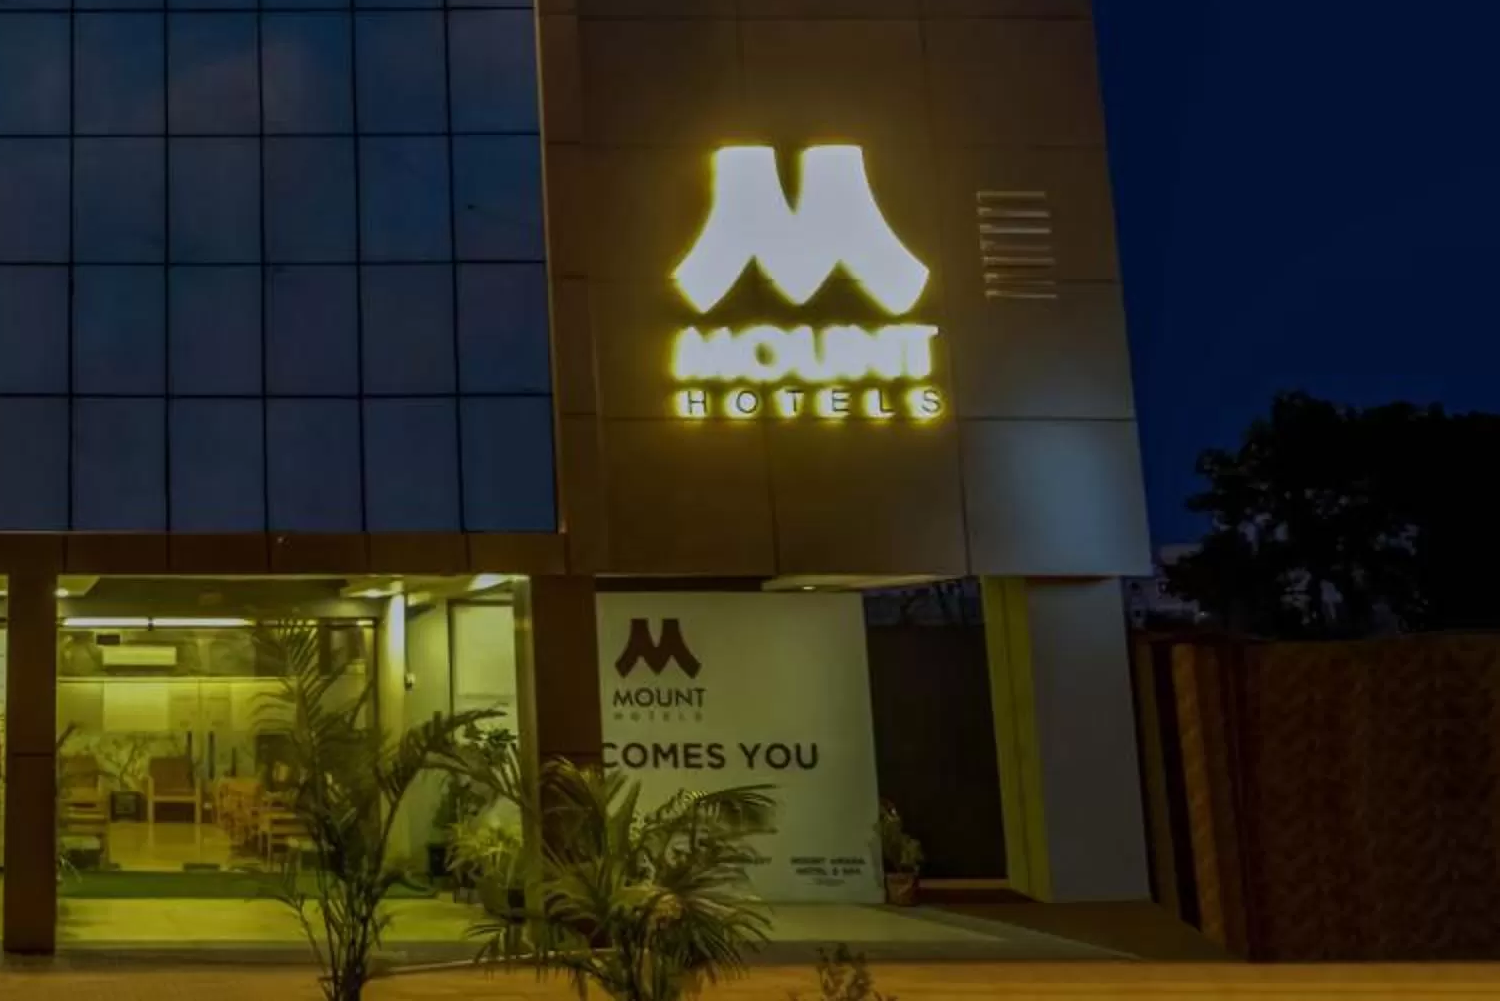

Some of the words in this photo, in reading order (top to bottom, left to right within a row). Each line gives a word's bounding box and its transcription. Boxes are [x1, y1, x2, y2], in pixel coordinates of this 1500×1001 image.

[673, 324, 939, 381] MOUNT
[681, 388, 943, 416] HOTELS
[612, 687, 706, 708] MOUNT
[739, 743, 819, 770] YOU
